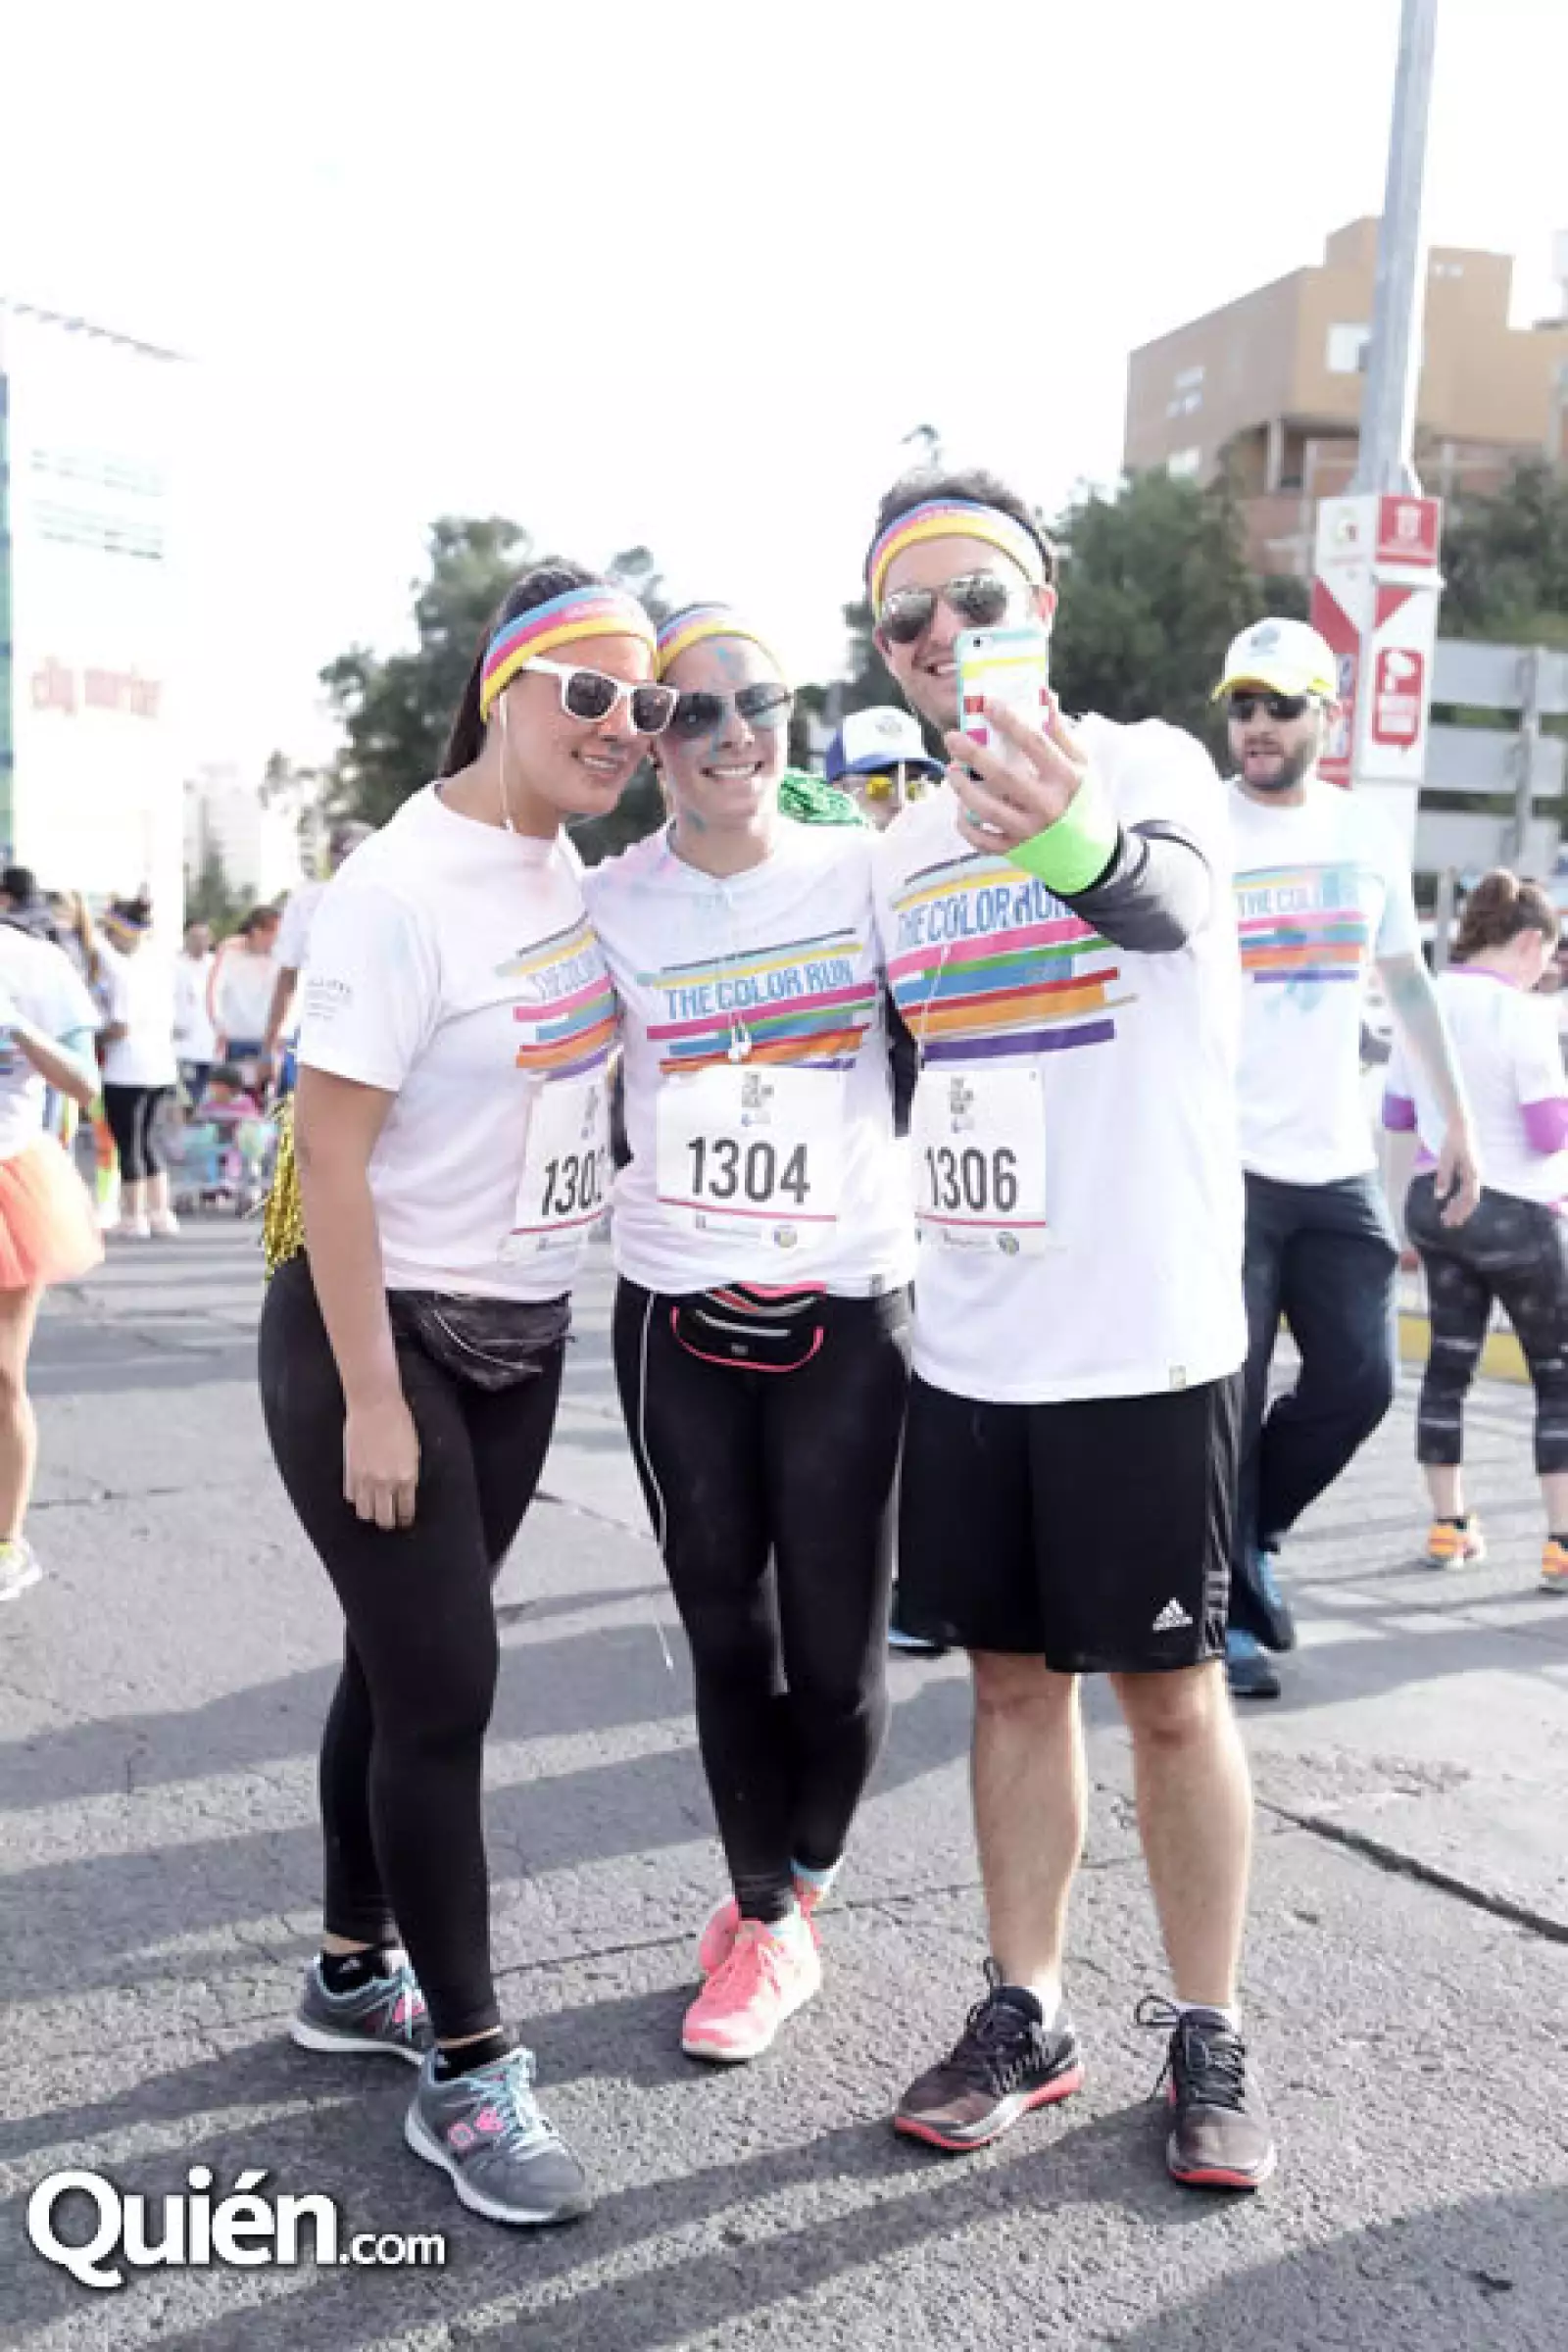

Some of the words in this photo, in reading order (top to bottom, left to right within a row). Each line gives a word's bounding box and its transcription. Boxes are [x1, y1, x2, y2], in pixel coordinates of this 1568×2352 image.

[927, 888, 1014, 943] COLOR
[667, 985, 716, 1020] THE
[715, 967, 804, 1009] COLOR
[804, 959, 854, 994] RUN
[686, 1136, 811, 1205] 1304
[924, 1146, 1018, 1212] 1306
